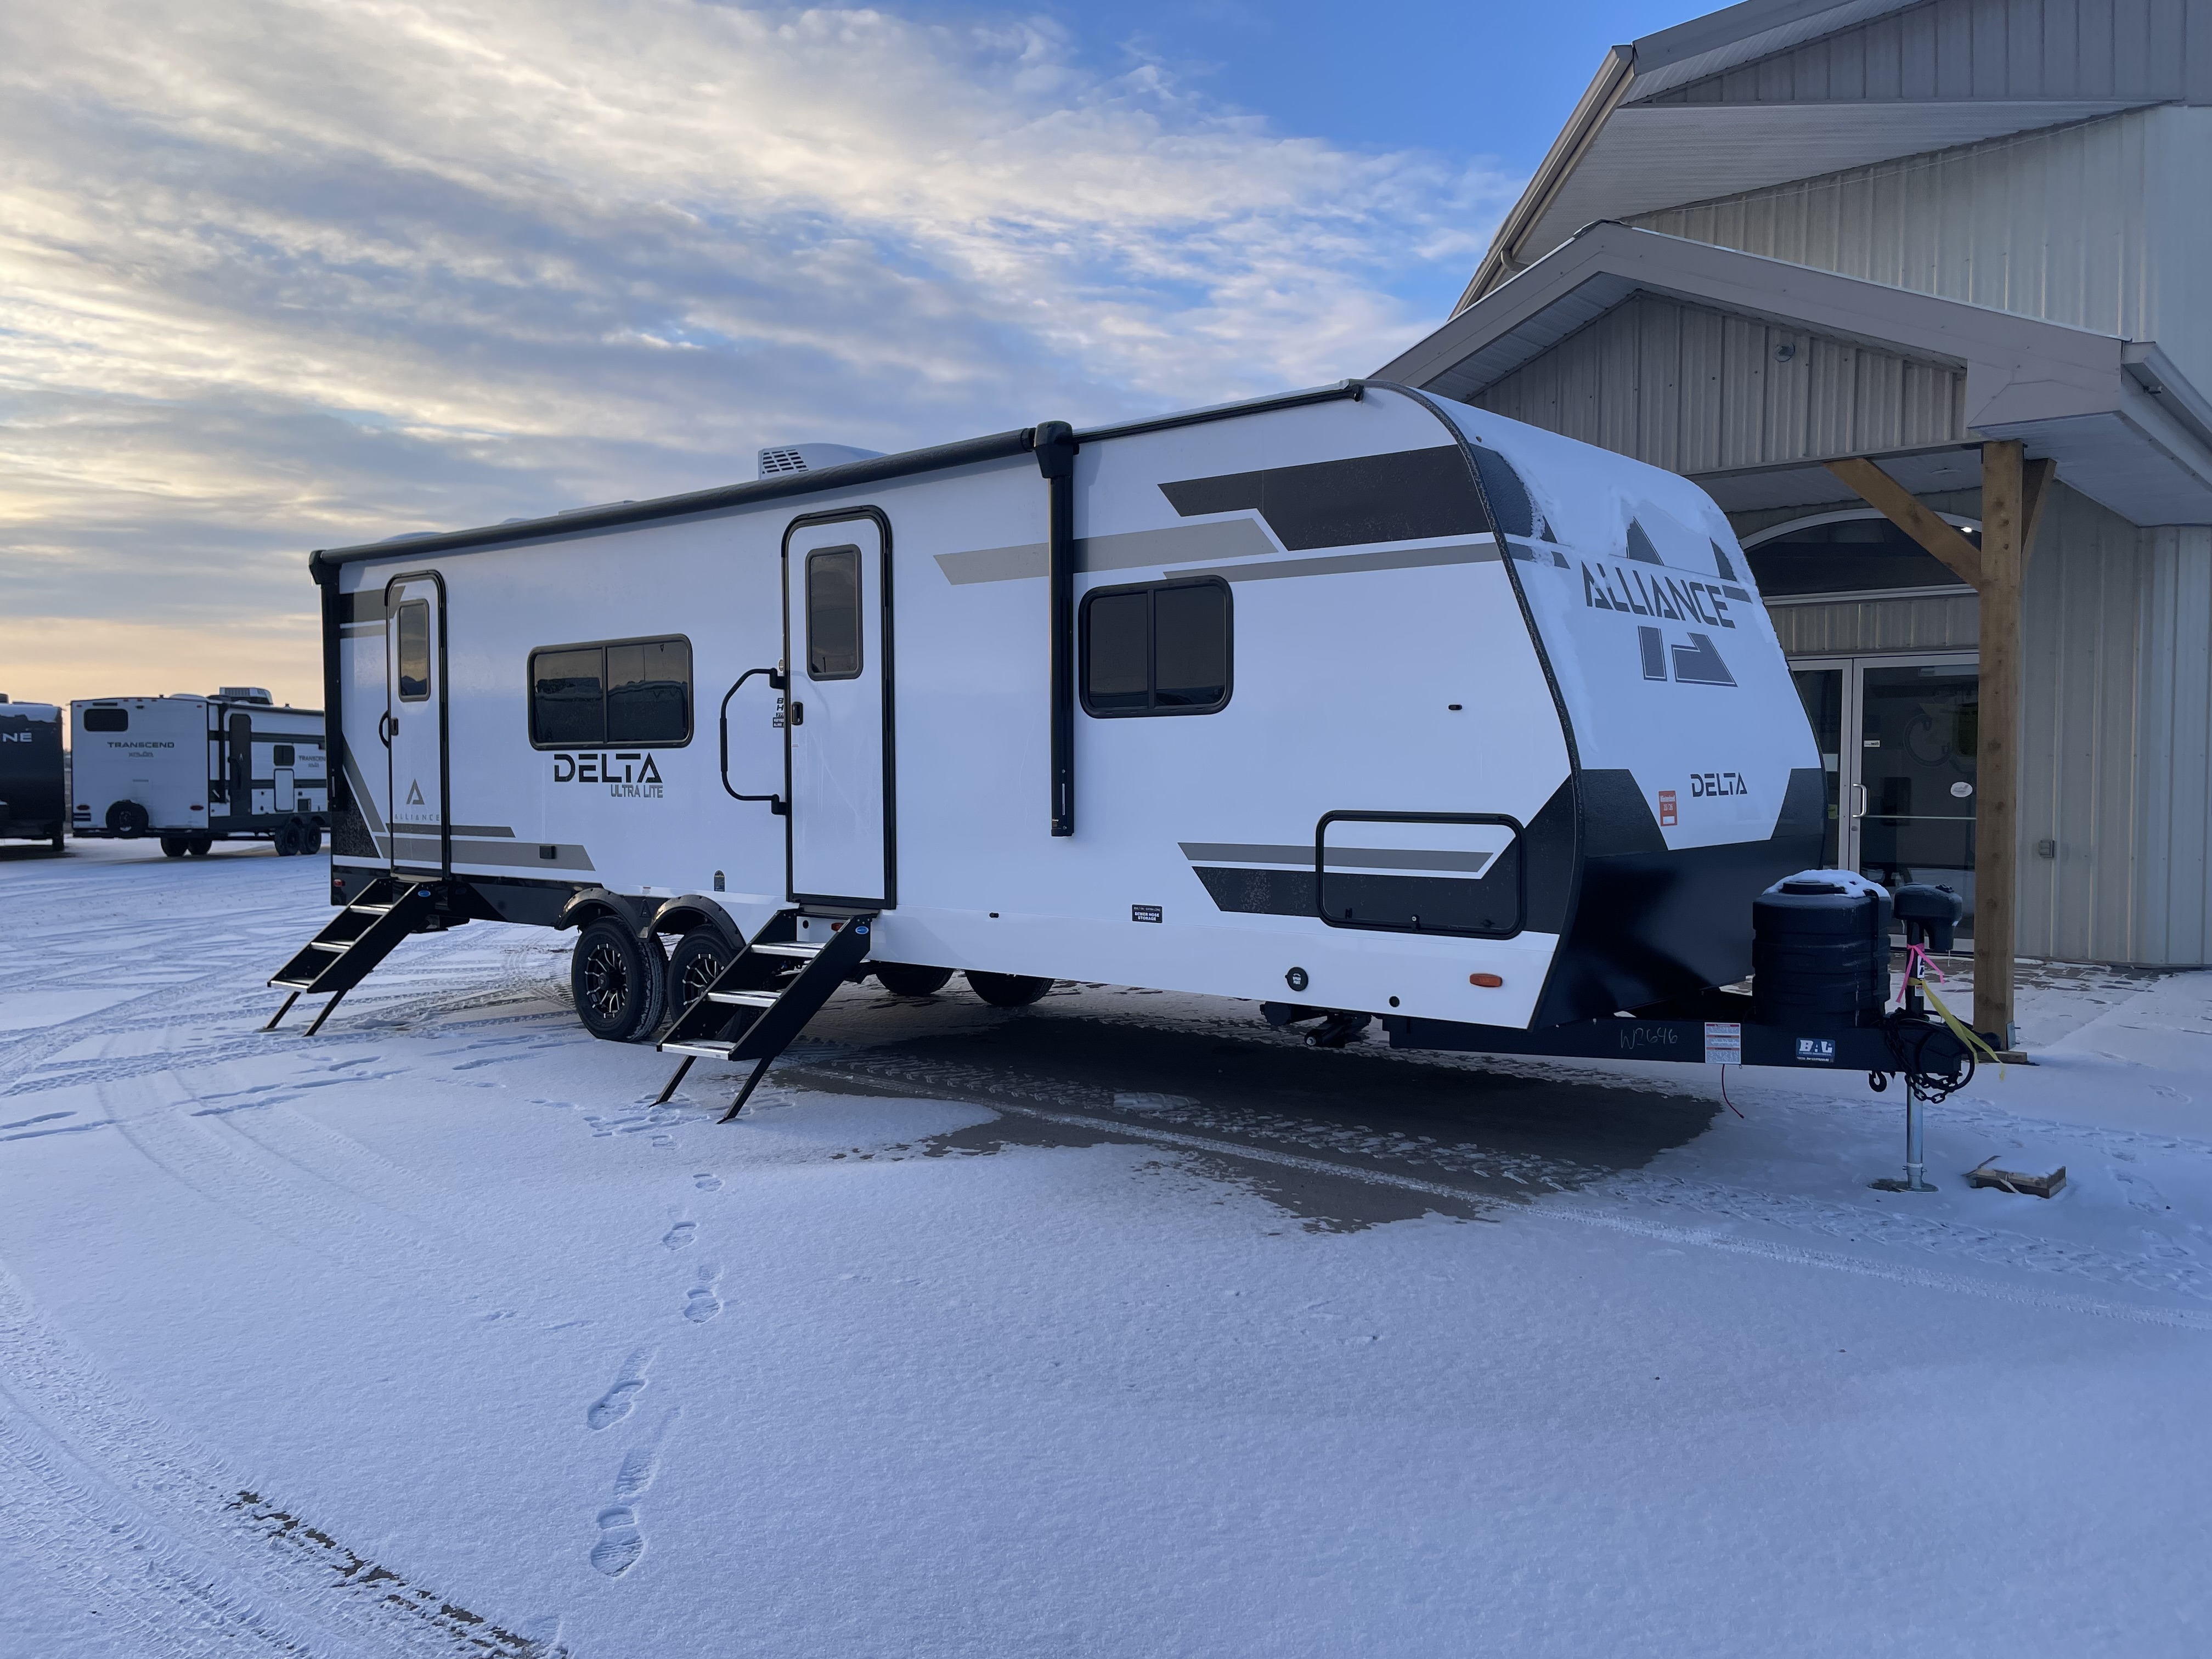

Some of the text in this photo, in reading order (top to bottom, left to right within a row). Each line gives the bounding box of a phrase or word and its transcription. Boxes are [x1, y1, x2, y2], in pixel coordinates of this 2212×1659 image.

[1581, 560, 1736, 629] ALLIANCE
[0, 732, 32, 742] NE
[554, 752, 663, 783] DELTA
[611, 783, 663, 798] ULTRA LITE
[1690, 772, 1748, 797] DELTA
